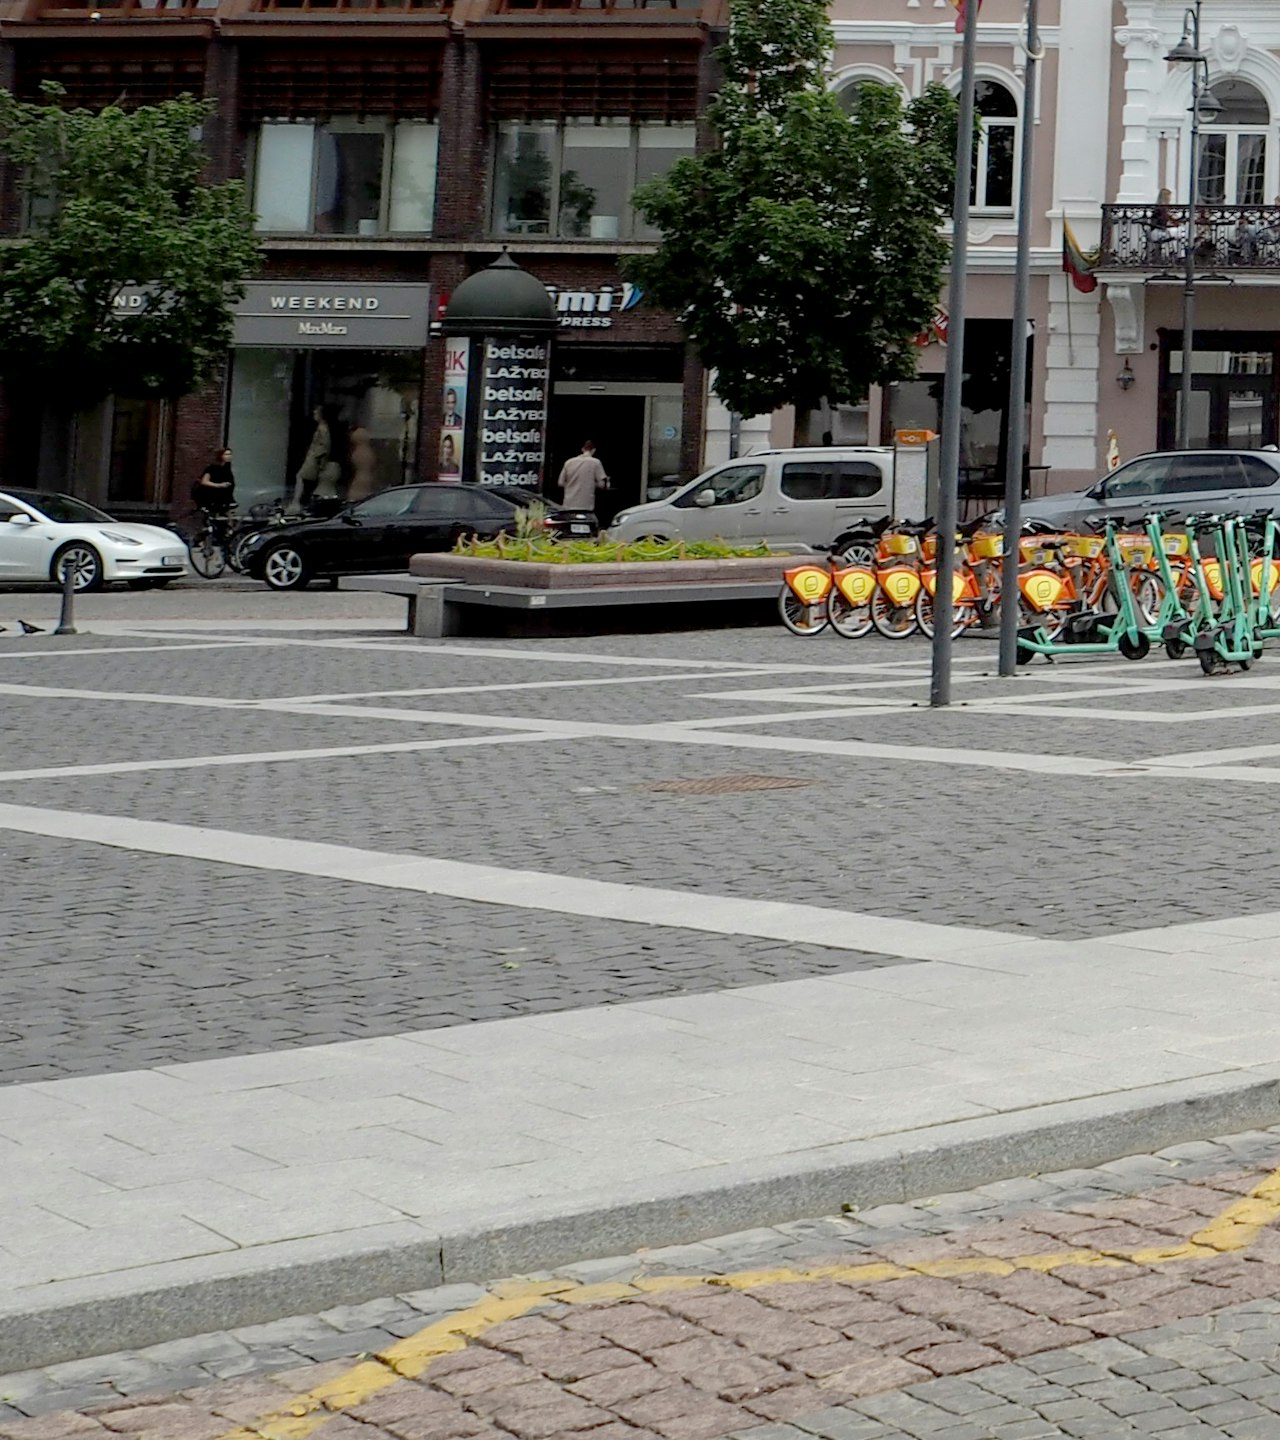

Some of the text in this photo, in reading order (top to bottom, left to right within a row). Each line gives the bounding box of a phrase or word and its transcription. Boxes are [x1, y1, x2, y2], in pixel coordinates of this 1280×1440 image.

[270, 296, 380, 310] WEEKEND
[298, 321, 348, 335] MaxMara
[487, 344, 546, 360] betsafe
[484, 386, 544, 401] betsafe
[482, 428, 542, 443] betsafe
[480, 470, 540, 485] betsafe
